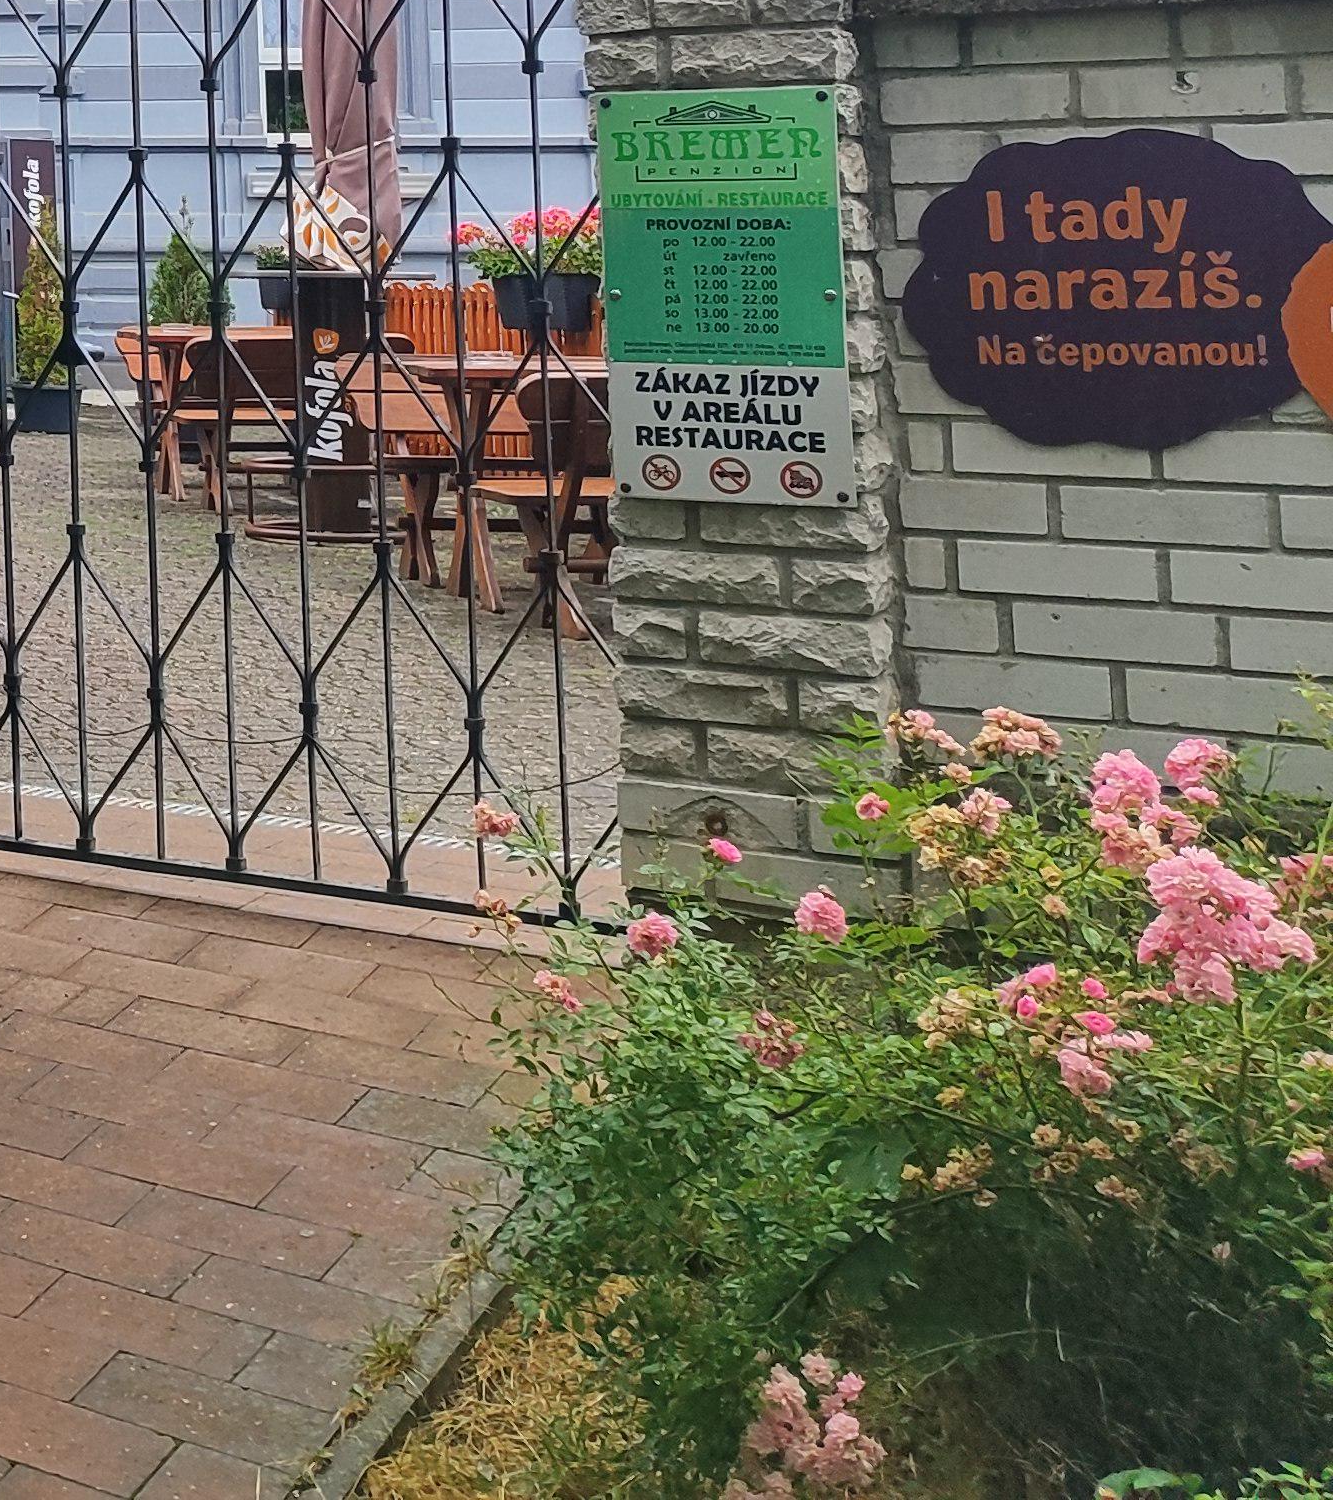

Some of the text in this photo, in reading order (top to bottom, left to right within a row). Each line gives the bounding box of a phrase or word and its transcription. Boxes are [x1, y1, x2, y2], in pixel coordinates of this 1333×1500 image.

[611, 127, 822, 162] BREMEN
[647, 165, 786, 175] PENZION
[22, 158, 47, 228] kofola
[610, 189, 703, 208] UBYTOVÁNÍ
[717, 191, 829, 207] RESTAURACE
[646, 217, 792, 231] PROVOZNÍ DOBA:
[985, 186, 1188, 254] I tady
[663, 238, 679, 249] po
[692, 236, 727, 247] 12.00
[739, 236, 775, 247] 22.00
[663, 250, 776, 261] út zavřeno
[663, 265, 674, 275] st
[693, 265, 727, 275] 12.00
[740, 265, 777, 276] 22.00
[664, 279, 676, 290] čt
[694, 279, 728, 290] 12.00
[741, 279, 778, 290] 22.00
[968, 250, 1263, 311] narazíš.
[665, 293, 681, 306] pá
[694, 294, 729, 304] 12.00
[741, 294, 778, 305] 22.00
[665, 309, 680, 318] so
[694, 308, 729, 318] 13.00
[742, 308, 779, 319] 22.00
[666, 323, 682, 333] ne
[695, 322, 730, 333] 13.00
[743, 323, 779, 334] 20.00
[976, 334, 1269, 373] Na čepovanou!
[634, 367, 820, 398] ZÁKAZ JÍZDY
[304, 360, 354, 462] kofola
[653, 398, 802, 426] V AREÁLU
[635, 425, 827, 454] RESTAURACE
